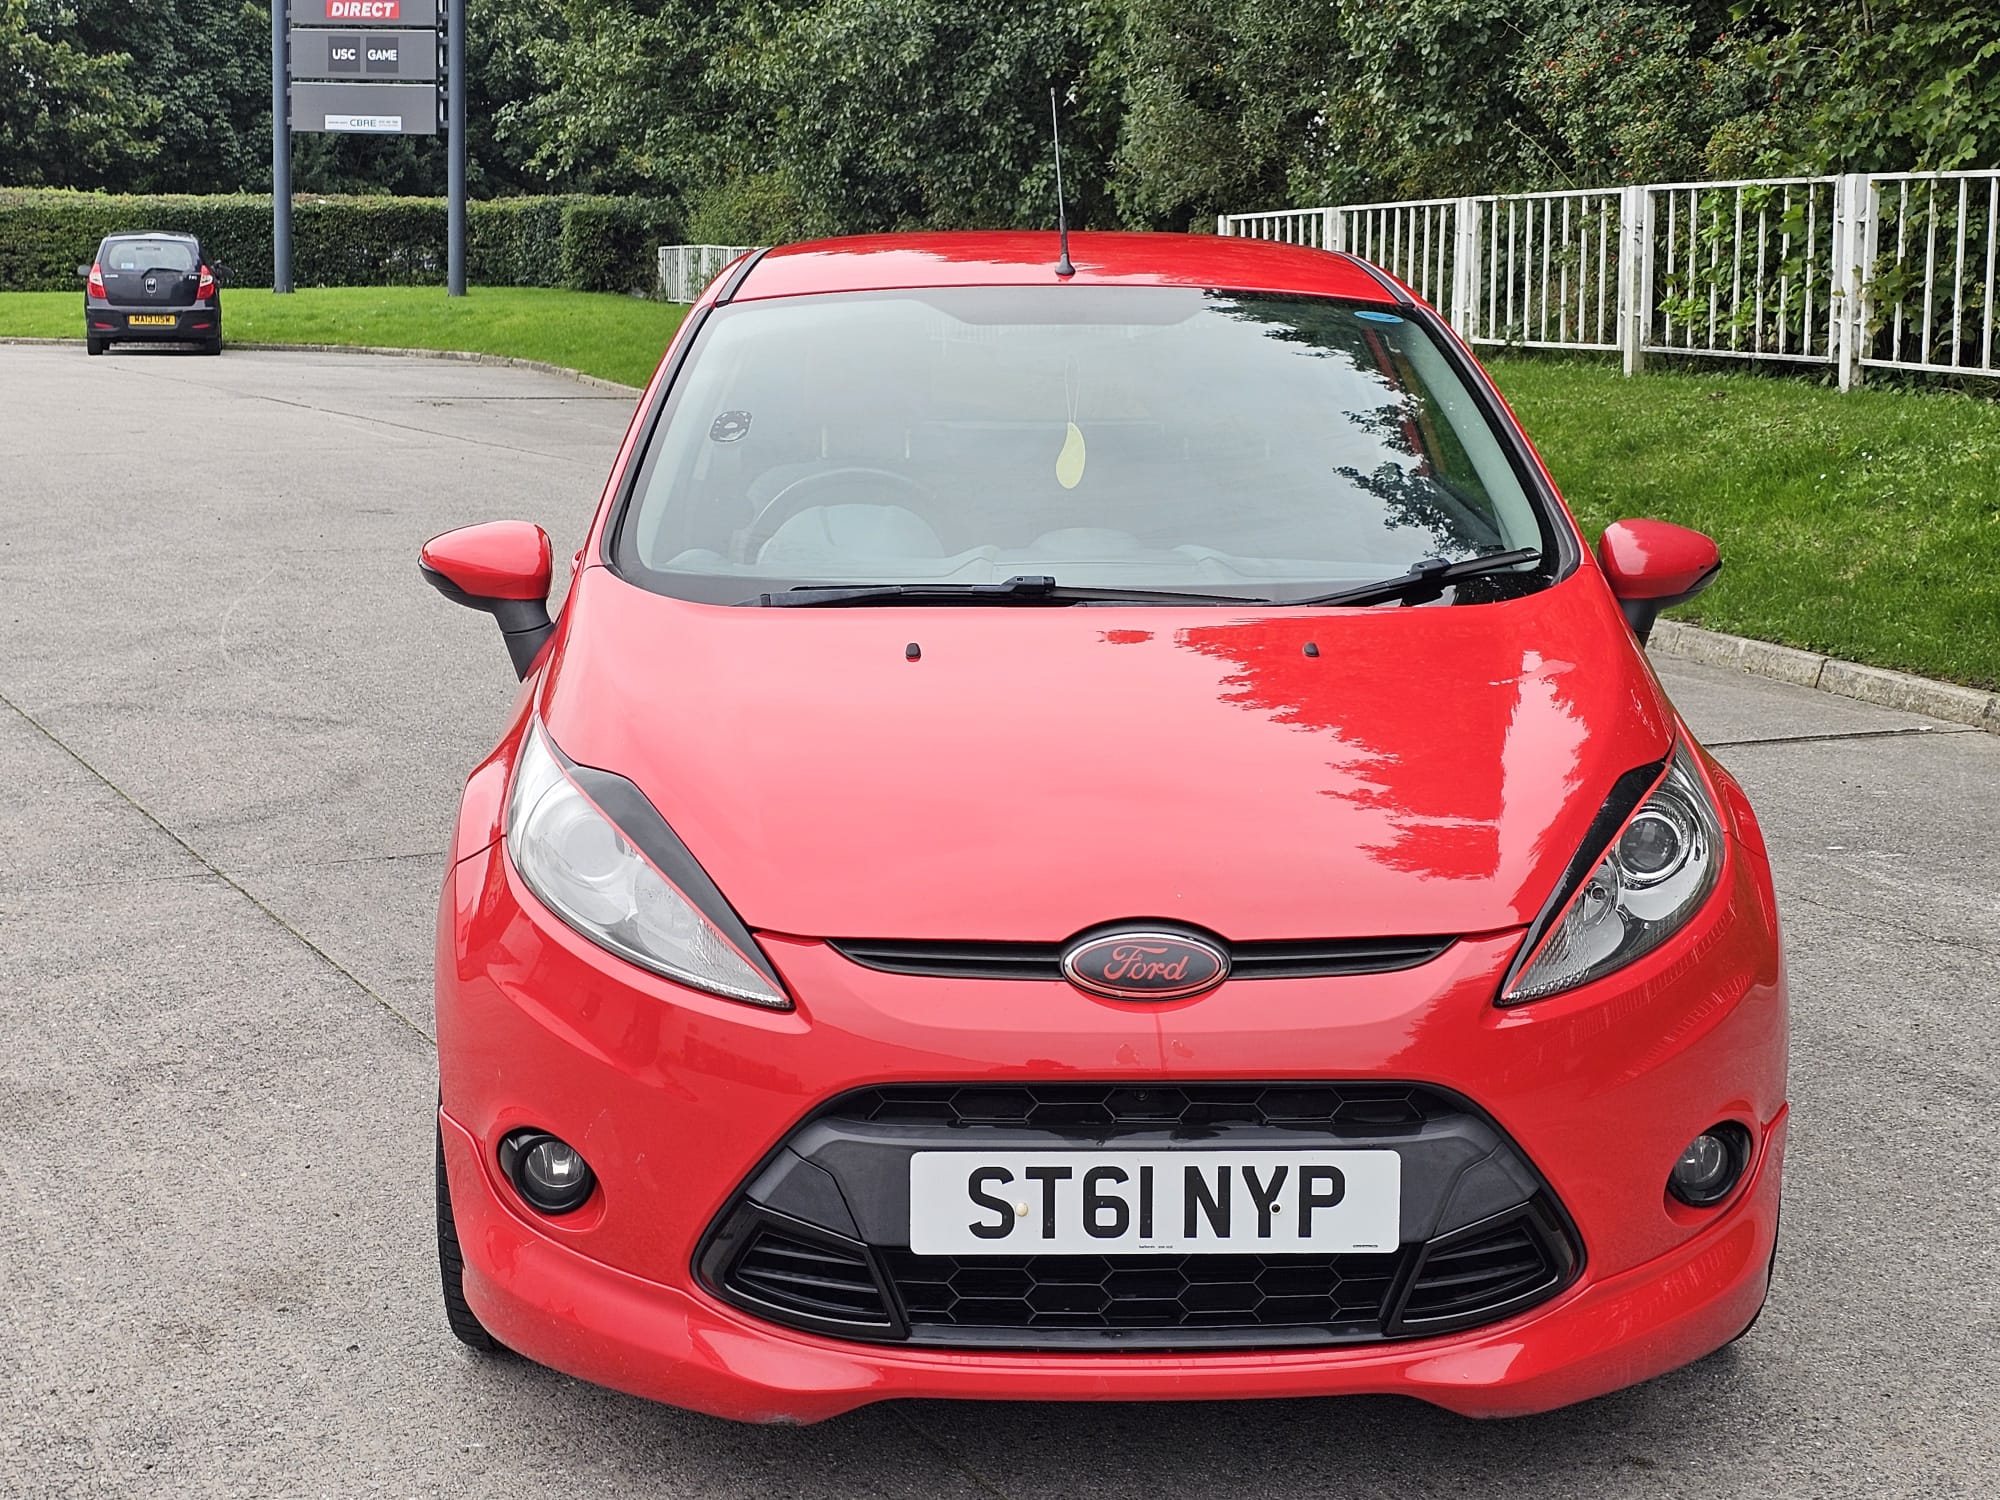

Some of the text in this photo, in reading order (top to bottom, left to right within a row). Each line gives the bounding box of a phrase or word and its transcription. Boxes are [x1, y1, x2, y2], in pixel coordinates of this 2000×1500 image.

[331, 1, 395, 17] DIRECT
[332, 48, 356, 60] USC
[367, 49, 397, 61] GAME
[350, 119, 376, 127] CBRE
[1103, 944, 1190, 980] Ford
[968, 1165, 1345, 1239] ST61 NYP
